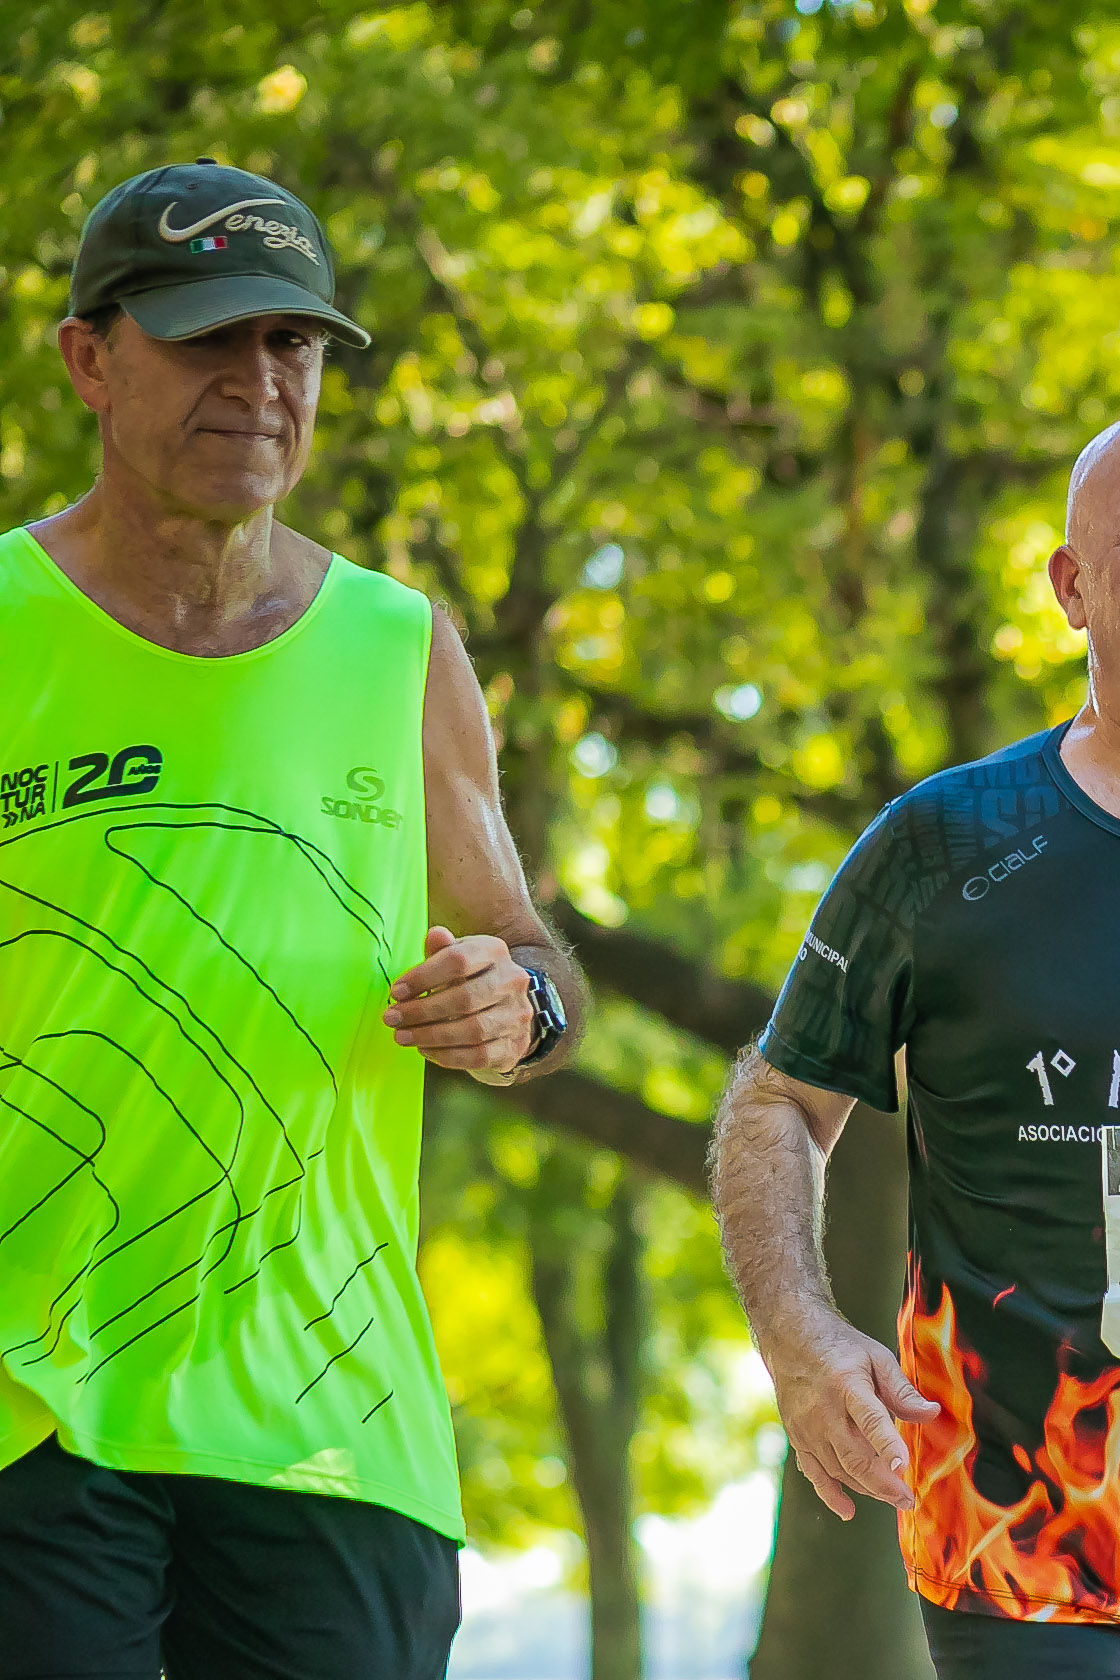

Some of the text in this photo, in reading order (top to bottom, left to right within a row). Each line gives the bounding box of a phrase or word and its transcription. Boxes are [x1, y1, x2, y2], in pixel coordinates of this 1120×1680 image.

[1, 764, 49, 793] NOC
[62, 744, 163, 809] 20
[0, 782, 46, 812] TUR
[20, 801, 46, 823] NA
